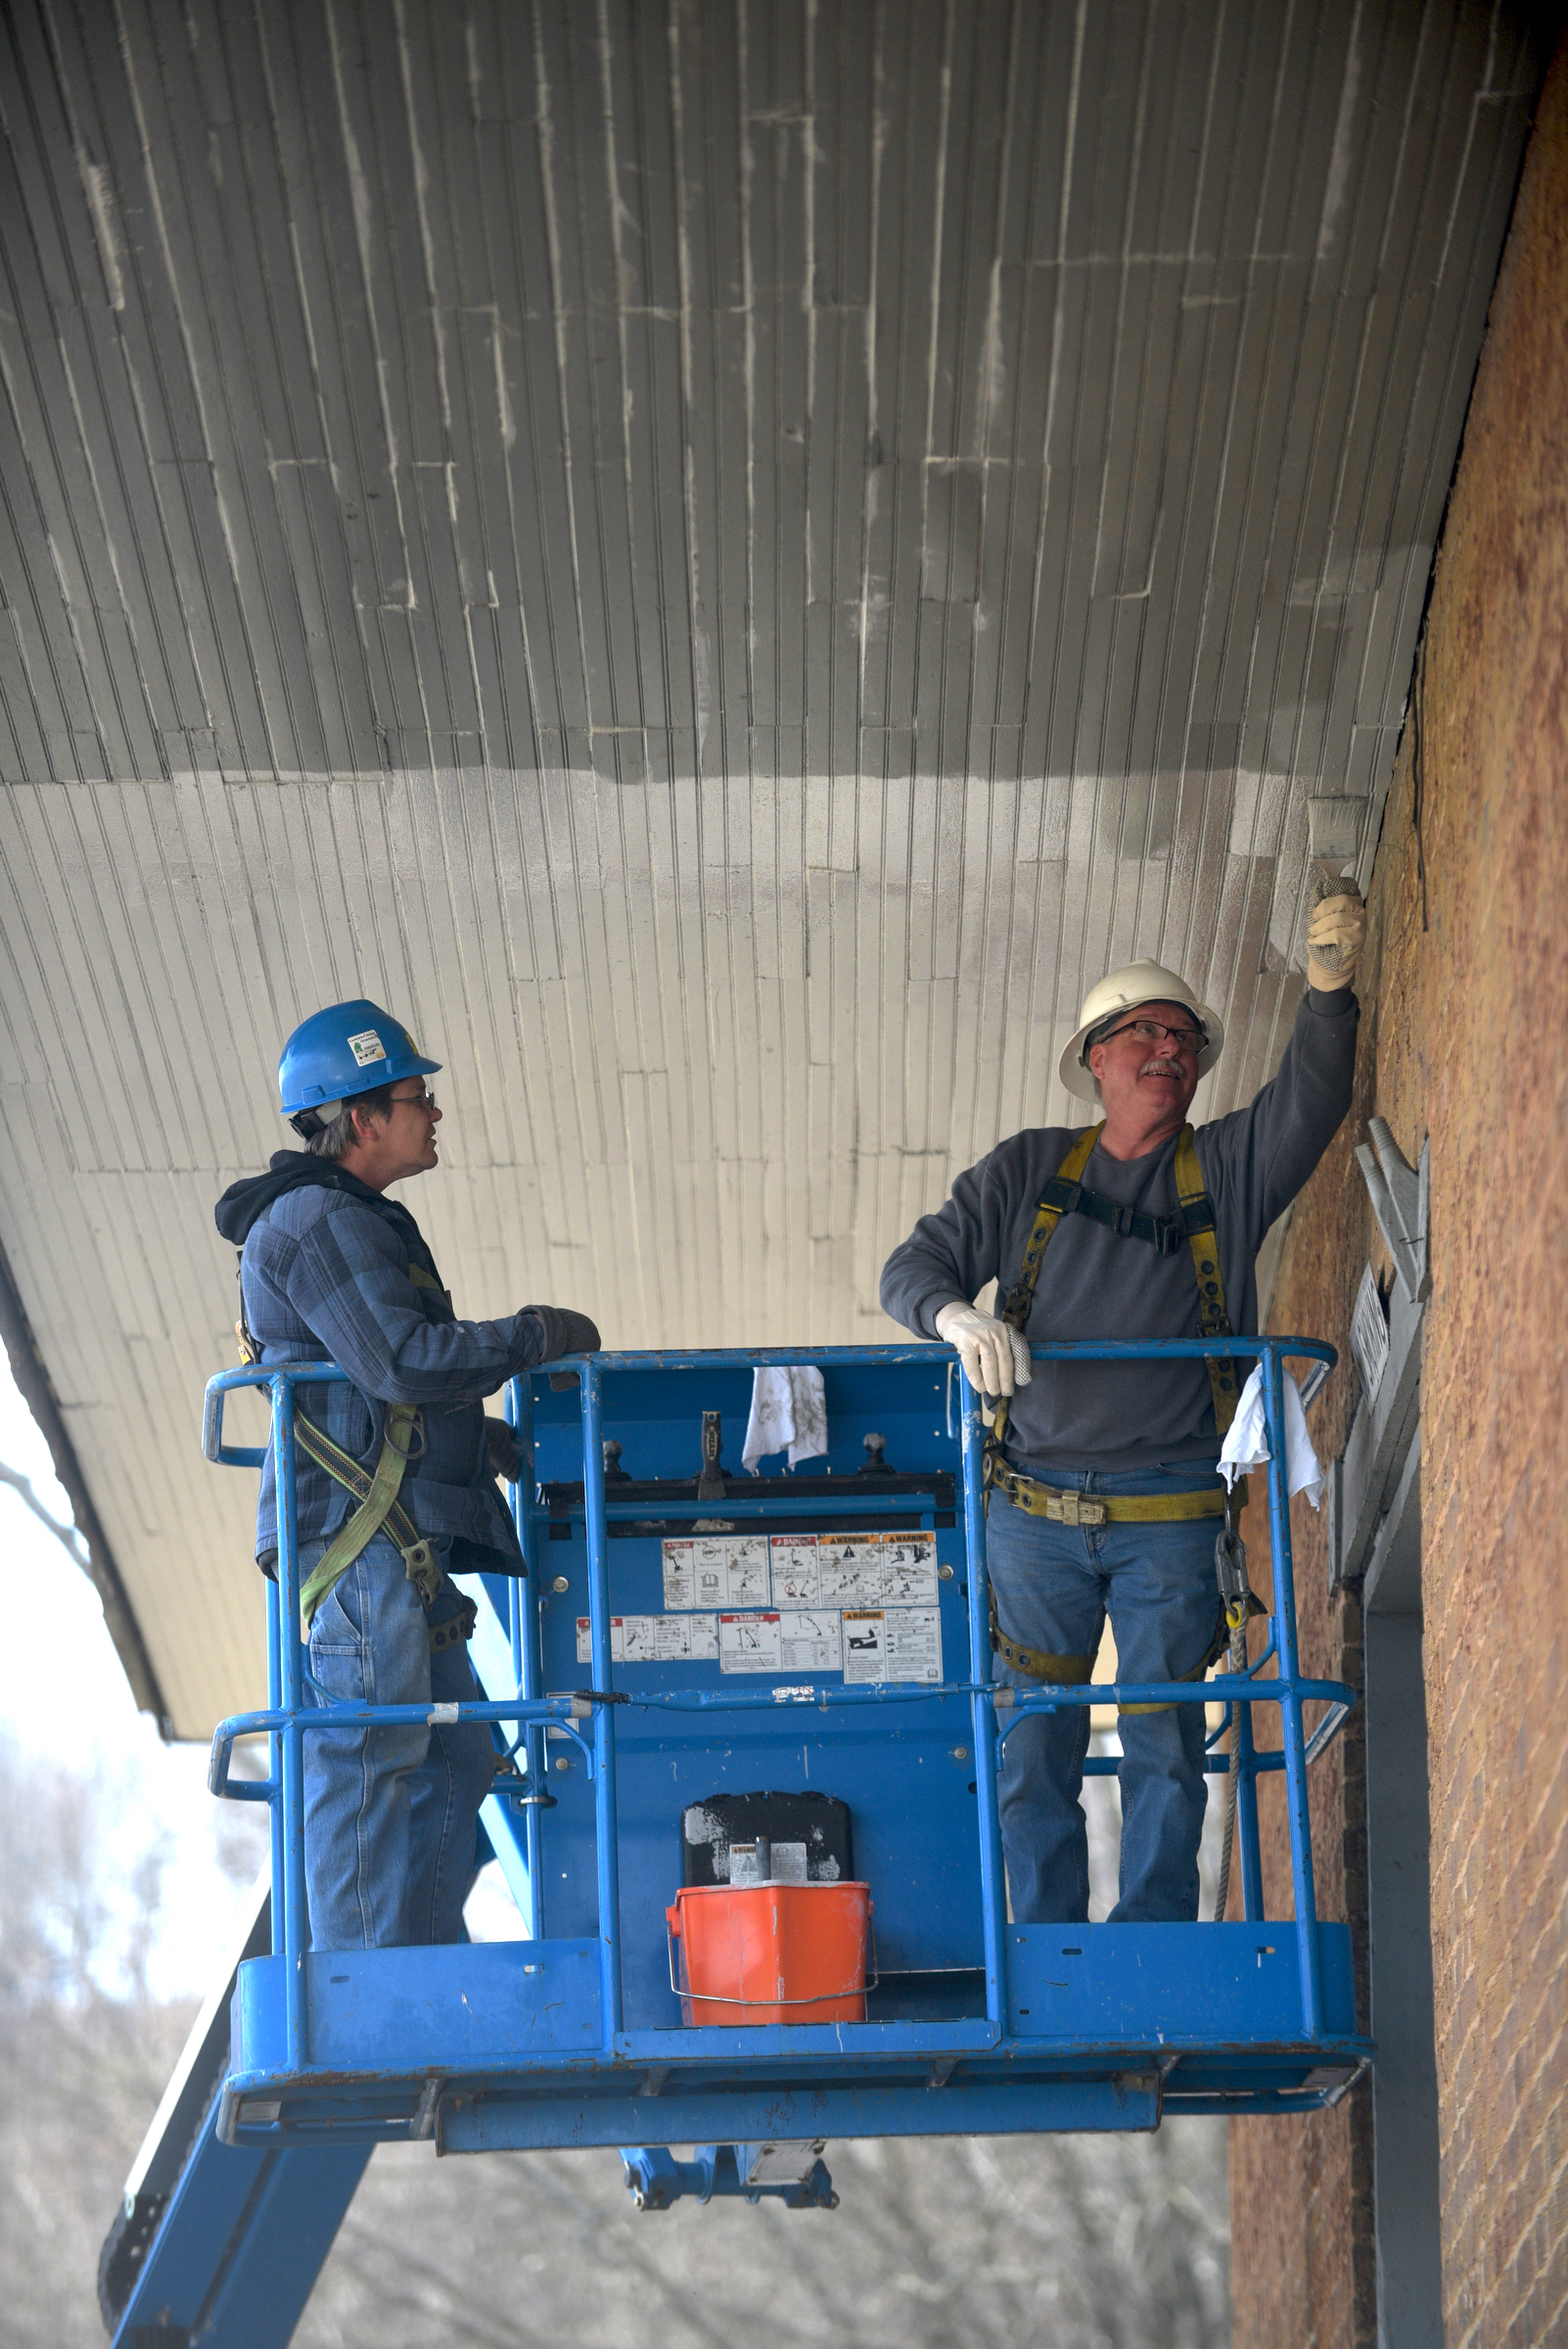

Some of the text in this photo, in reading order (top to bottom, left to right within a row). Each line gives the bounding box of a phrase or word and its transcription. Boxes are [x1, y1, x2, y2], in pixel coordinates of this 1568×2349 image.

[837, 1536, 869, 1544] WARNING
[896, 1534, 928, 1543] WARNING
[853, 1611, 882, 1620] WARNING
